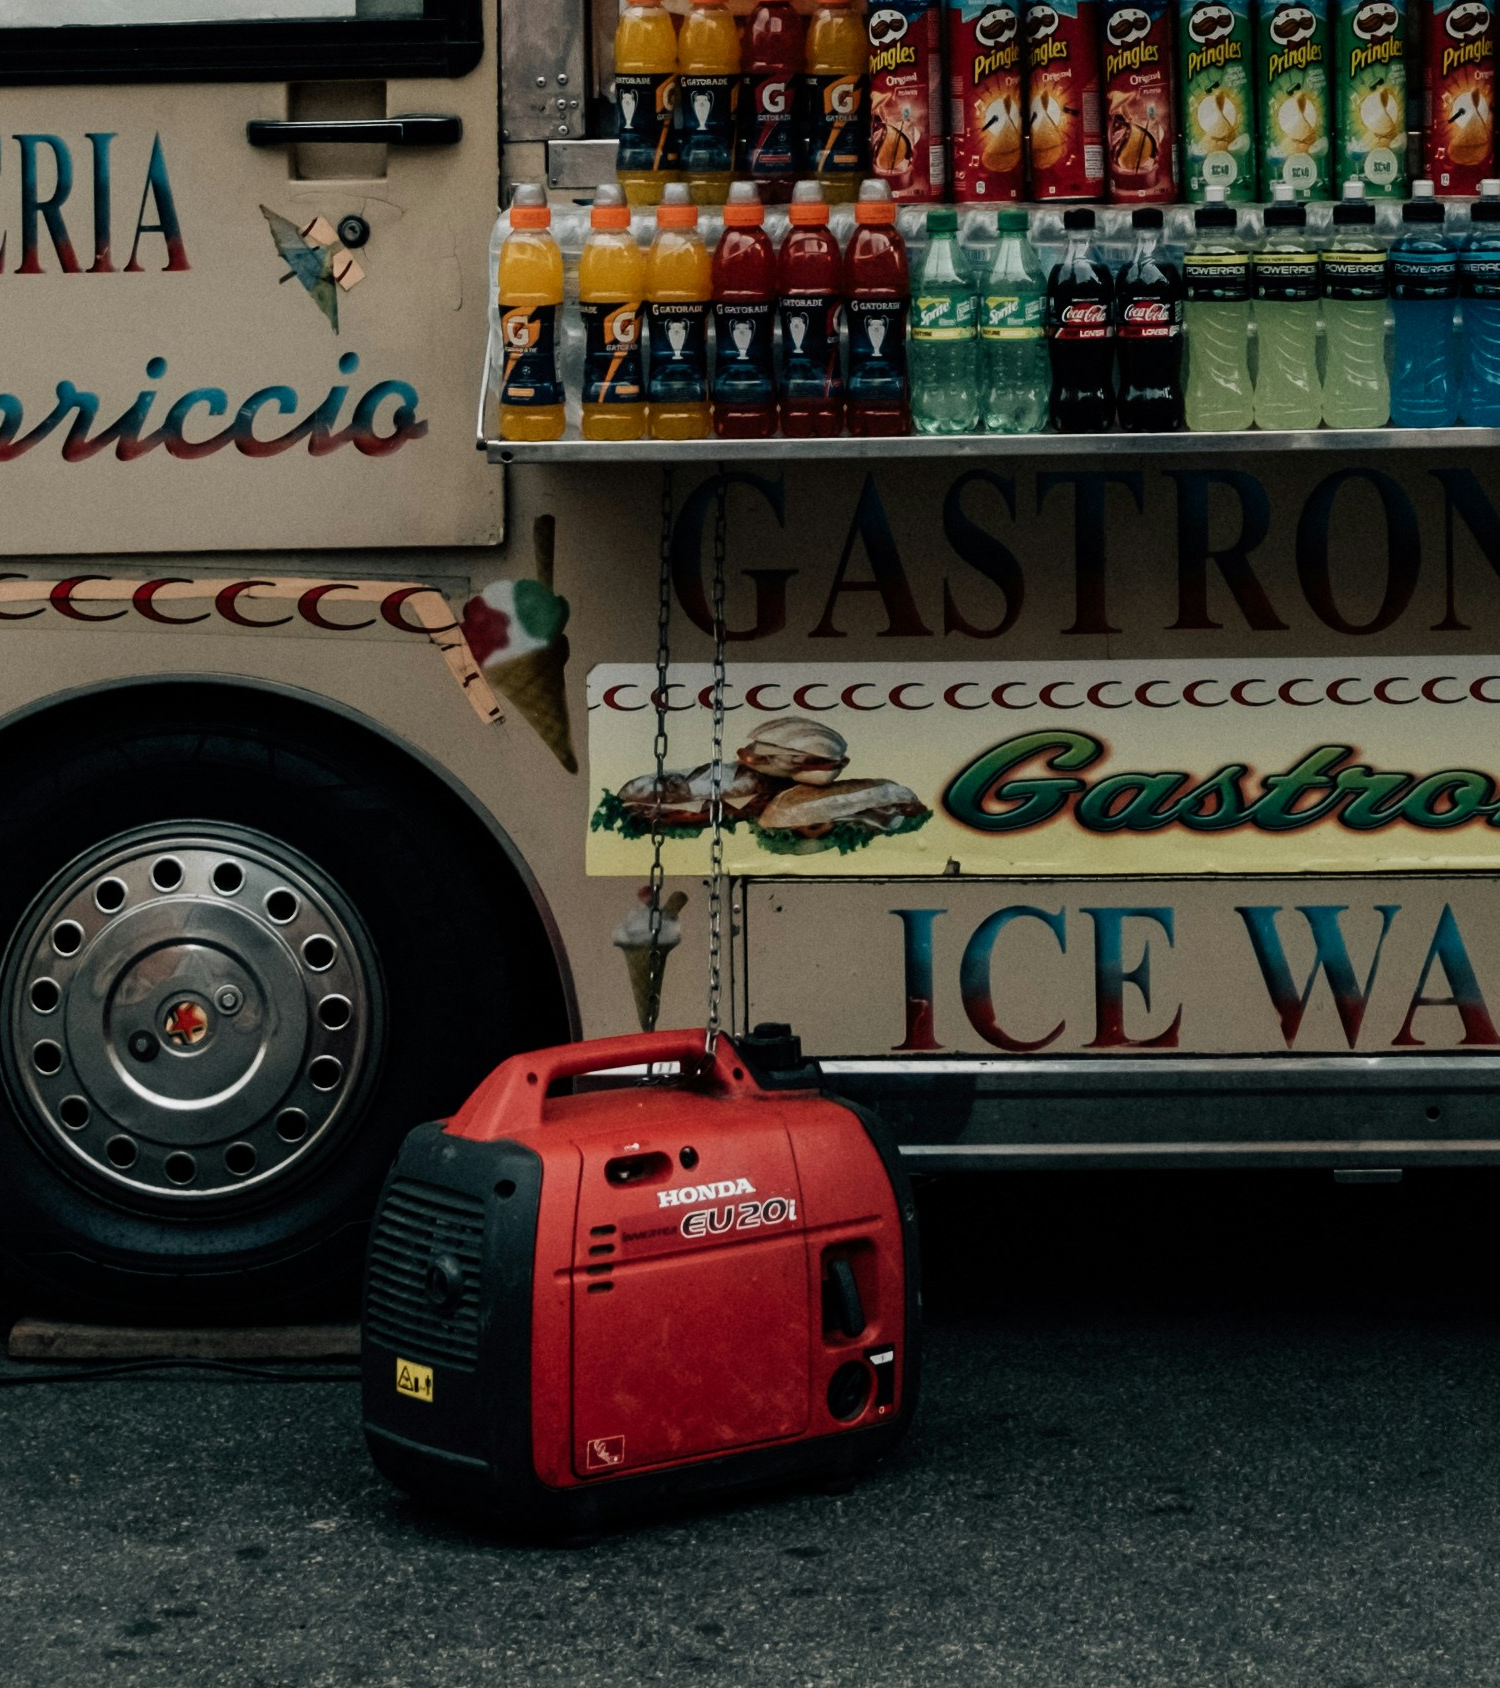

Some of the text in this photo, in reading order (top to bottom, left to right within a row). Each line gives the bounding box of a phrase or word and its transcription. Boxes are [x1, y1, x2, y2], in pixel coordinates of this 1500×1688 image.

[1106, 40, 1160, 82] Pringles
[1188, 38, 1242, 80] Pringles
[1268, 41, 1322, 83] Pringles
[1350, 35, 1403, 79] Pringles
[687, 78, 728, 86] GATORADE
[761, 82, 785, 113] G
[830, 83, 855, 114] G
[1186, 265, 1246, 275] POWERADE
[1256, 265, 1316, 275] POWERADE
[1324, 262, 1385, 274] POWERADE
[659, 304, 704, 315] GATORADE
[724, 304, 769, 315] GATORADE
[782, 298, 824, 309] GATORADE
[859, 300, 902, 311] GATORADE
[920, 300, 950, 324] Sprite
[988, 300, 1018, 323] Sprite
[1061, 303, 1108, 323] Coca-Cola
[1124, 302, 1171, 322] Coca-Cola
[505, 315, 531, 346] G
[611, 312, 639, 342] G
[1078, 328, 1105, 338] LOVER
[1141, 327, 1168, 337] LOVER
[890, 905, 1183, 1057] ICE
[656, 1177, 756, 1209] HONDA
